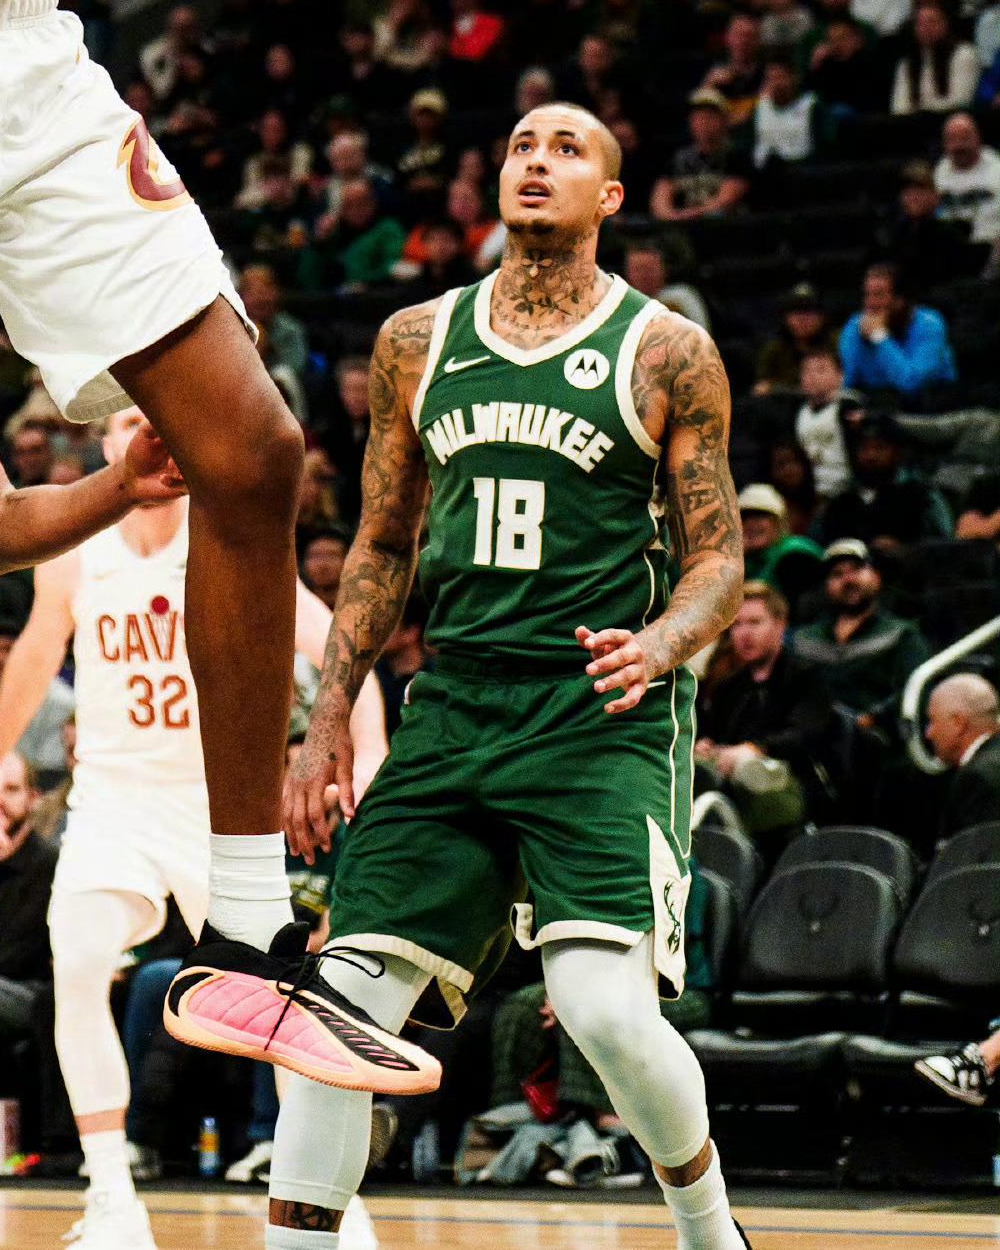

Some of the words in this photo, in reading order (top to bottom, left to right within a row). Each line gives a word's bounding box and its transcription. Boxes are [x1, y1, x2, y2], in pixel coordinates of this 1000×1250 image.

[425, 401, 615, 474] MILWAUKEE
[472, 477, 545, 570] 18
[97, 611, 185, 662] CAV
[127, 674, 190, 729] 32
